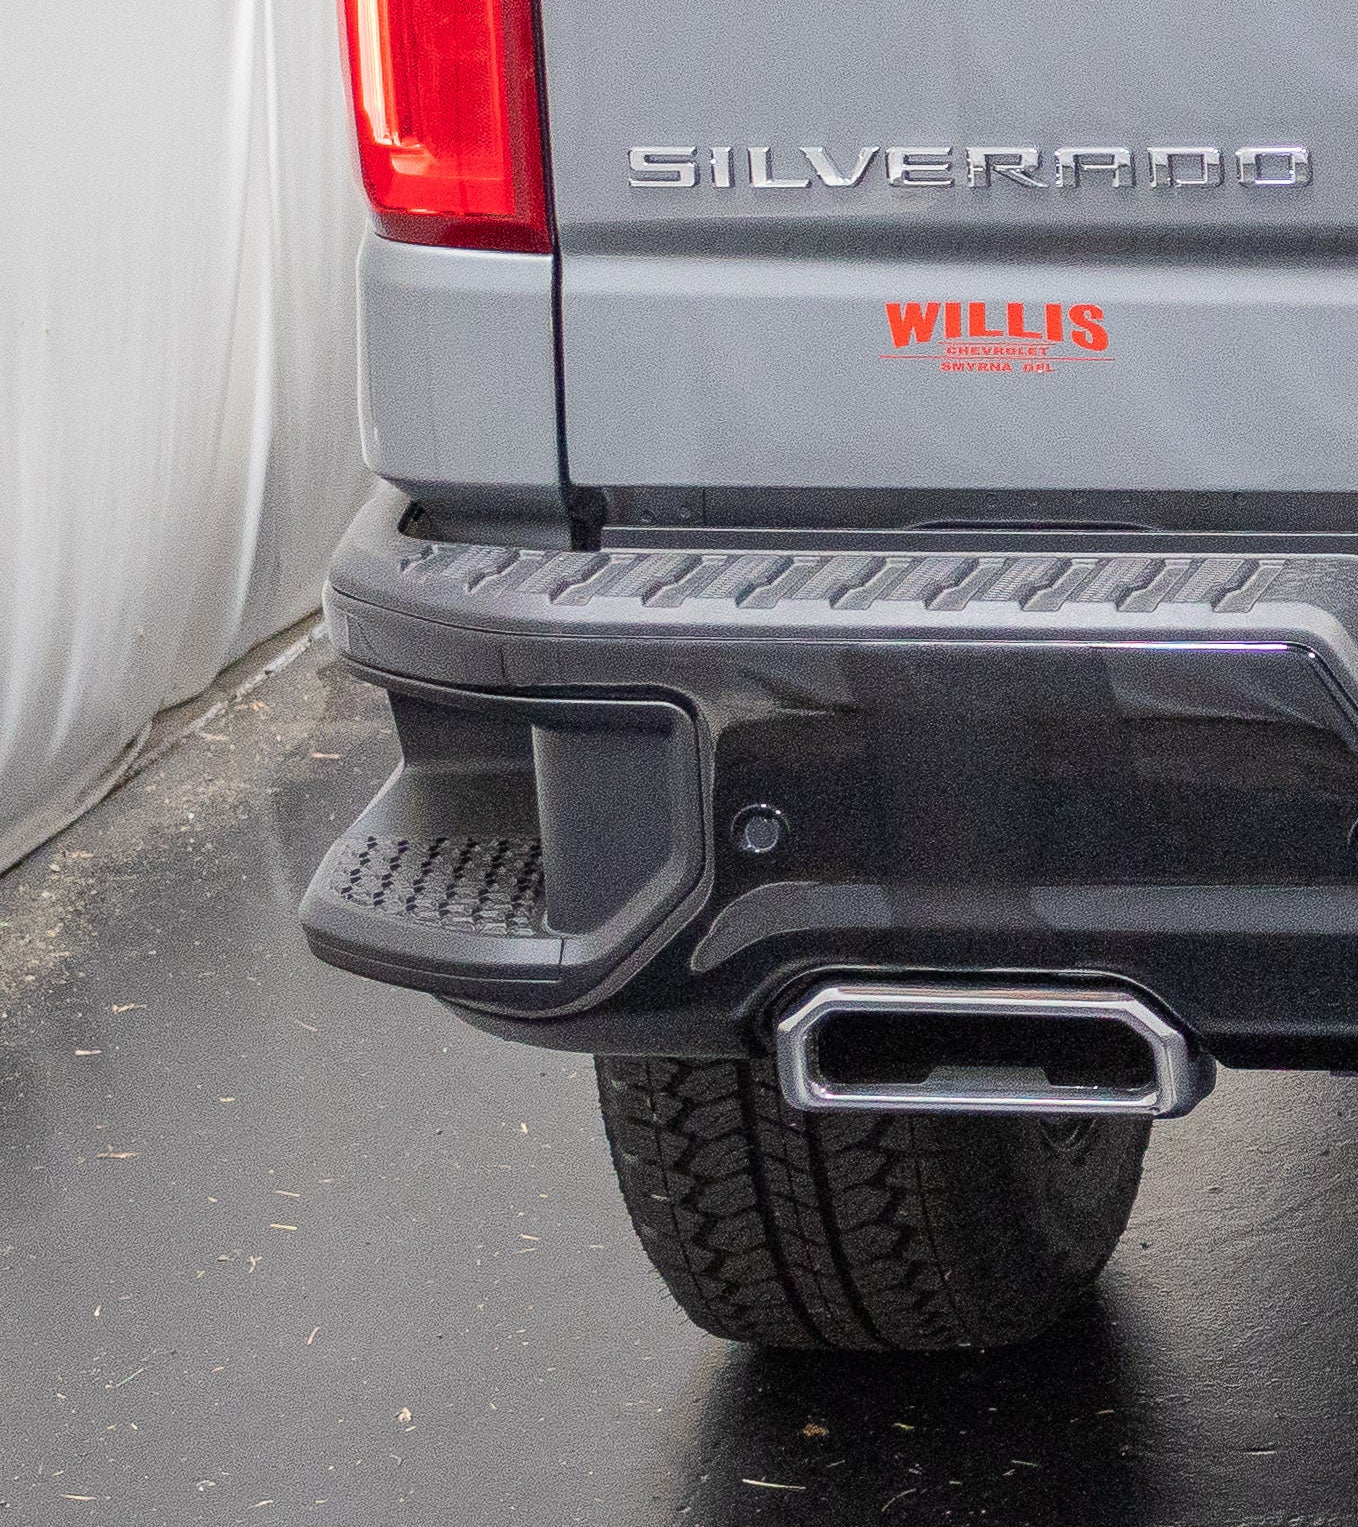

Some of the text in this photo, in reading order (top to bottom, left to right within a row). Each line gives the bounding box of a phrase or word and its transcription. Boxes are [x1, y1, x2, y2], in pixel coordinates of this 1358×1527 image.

[627, 145, 1311, 189] SILVERADO
[885, 301, 1109, 352] WILLIS
[945, 346, 1049, 356] CHEVROLET
[940, 362, 1012, 372] SMYRNA
